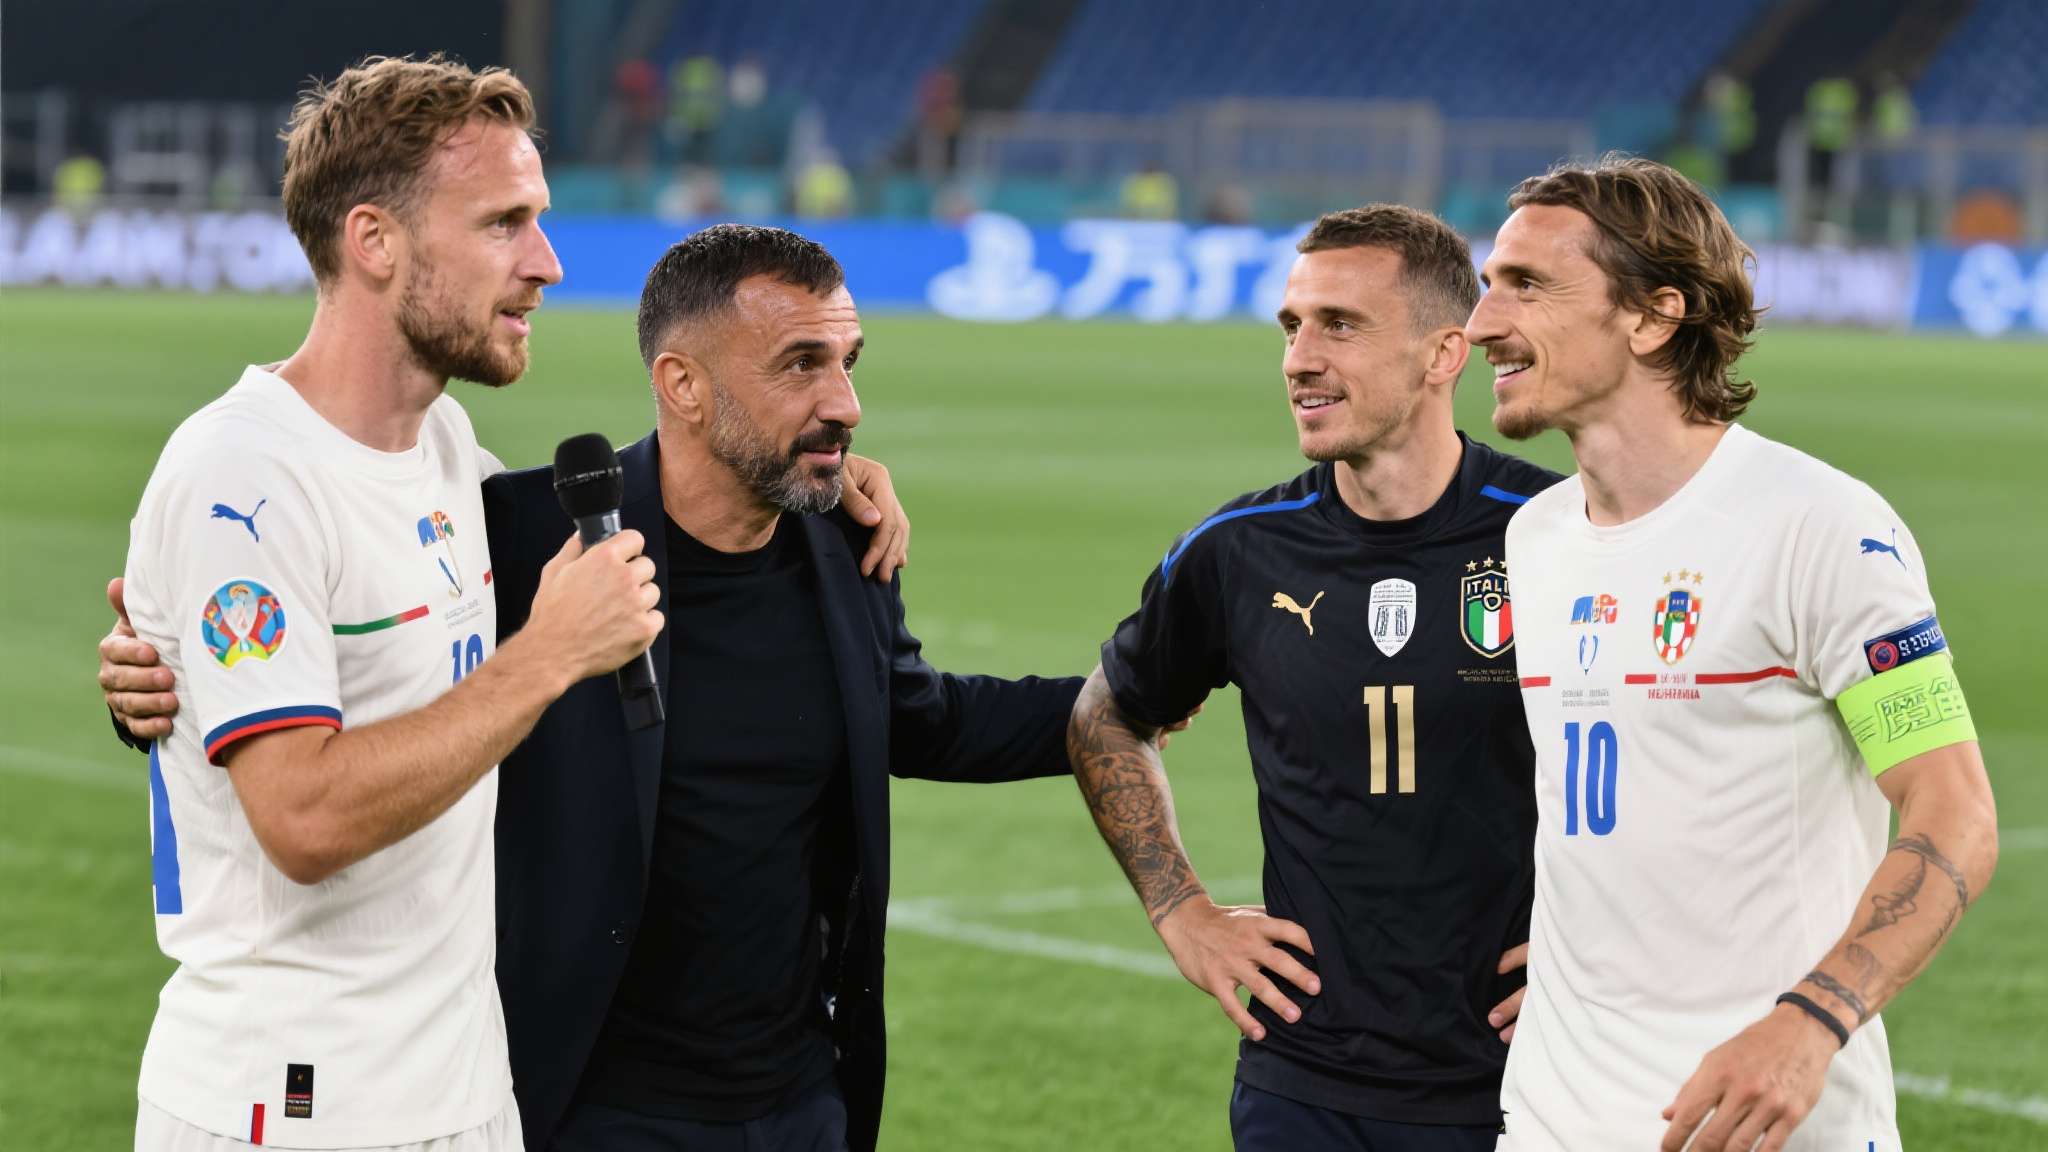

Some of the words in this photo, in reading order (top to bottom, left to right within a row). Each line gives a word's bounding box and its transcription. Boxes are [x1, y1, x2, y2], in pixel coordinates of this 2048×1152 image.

[452, 633, 484, 688] 10
[1363, 685, 1416, 794] 11
[1563, 720, 1618, 836] 10
